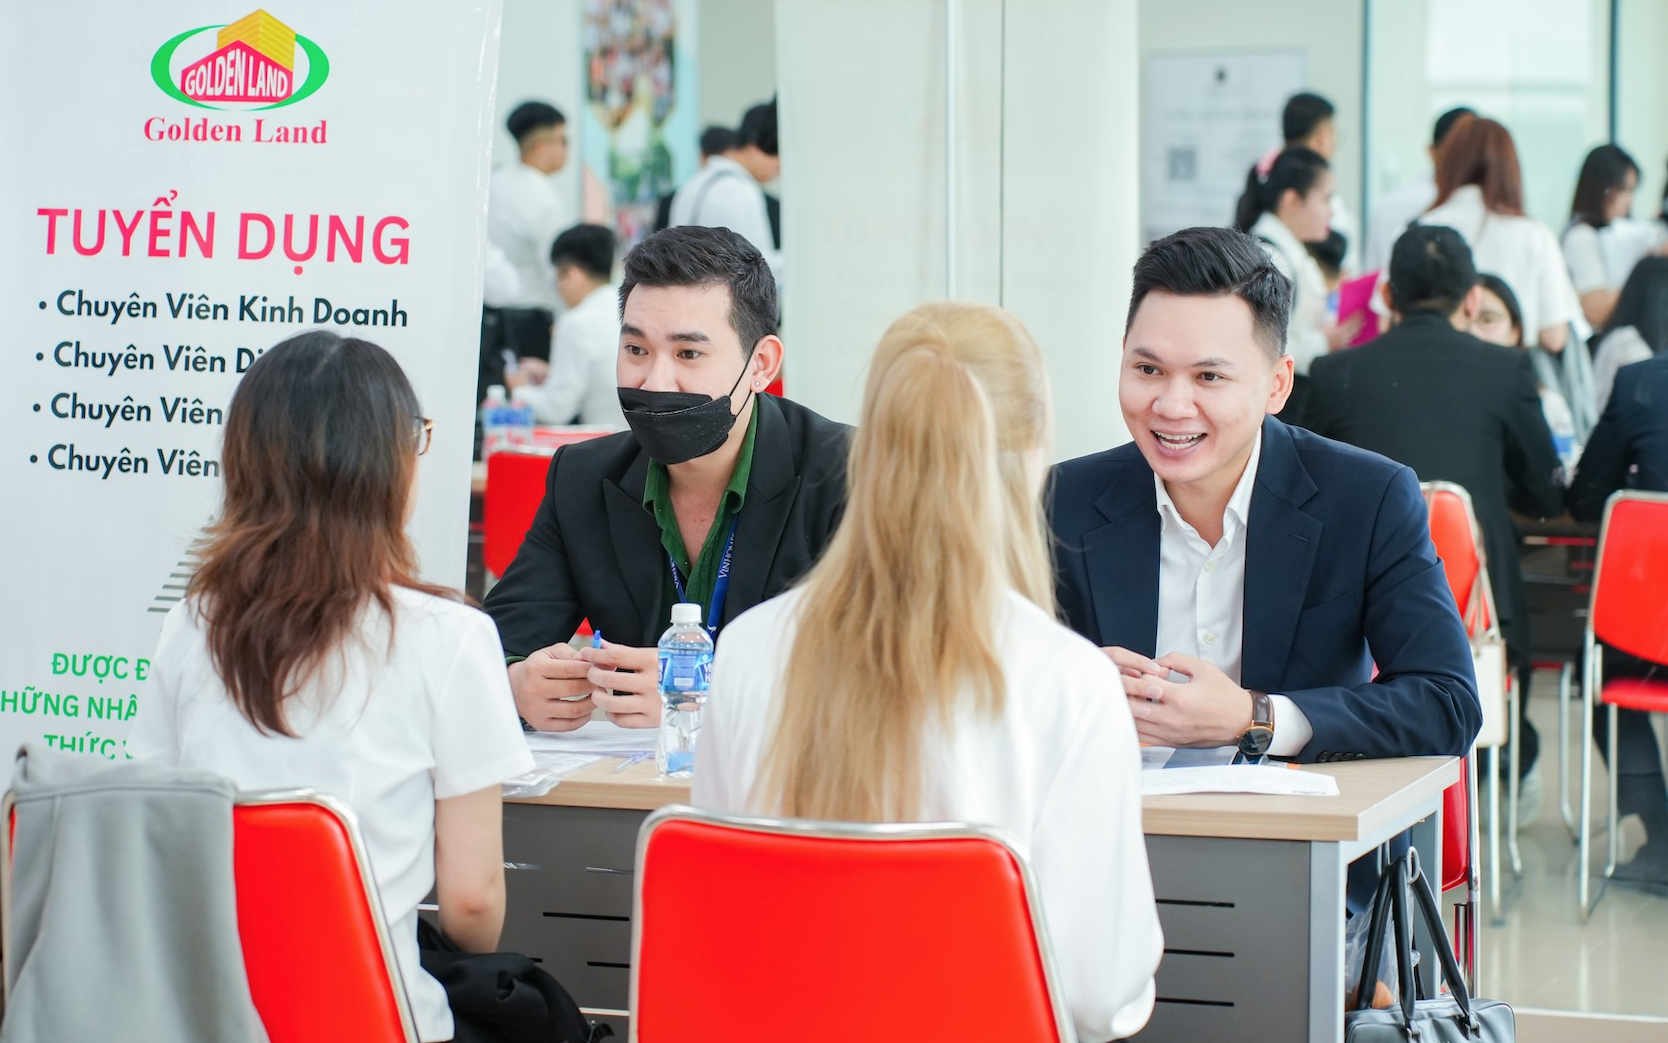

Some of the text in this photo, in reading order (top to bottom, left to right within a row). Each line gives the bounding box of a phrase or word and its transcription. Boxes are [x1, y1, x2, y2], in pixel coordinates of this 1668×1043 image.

[185, 48, 289, 98] GOLDEN LAND
[143, 116, 327, 144] Golden Land
[37, 190, 411, 275] TUYỂN DỤNG
[56, 289, 408, 327] Chuyên Viên Kinh Doanh
[53, 341, 155, 376] Chuyên
[163, 344, 227, 373] Viên
[50, 392, 223, 428] Chuyên Viên
[47, 443, 220, 479] Chuyên Viên
[51, 652, 129, 684] ĐƯỢC
